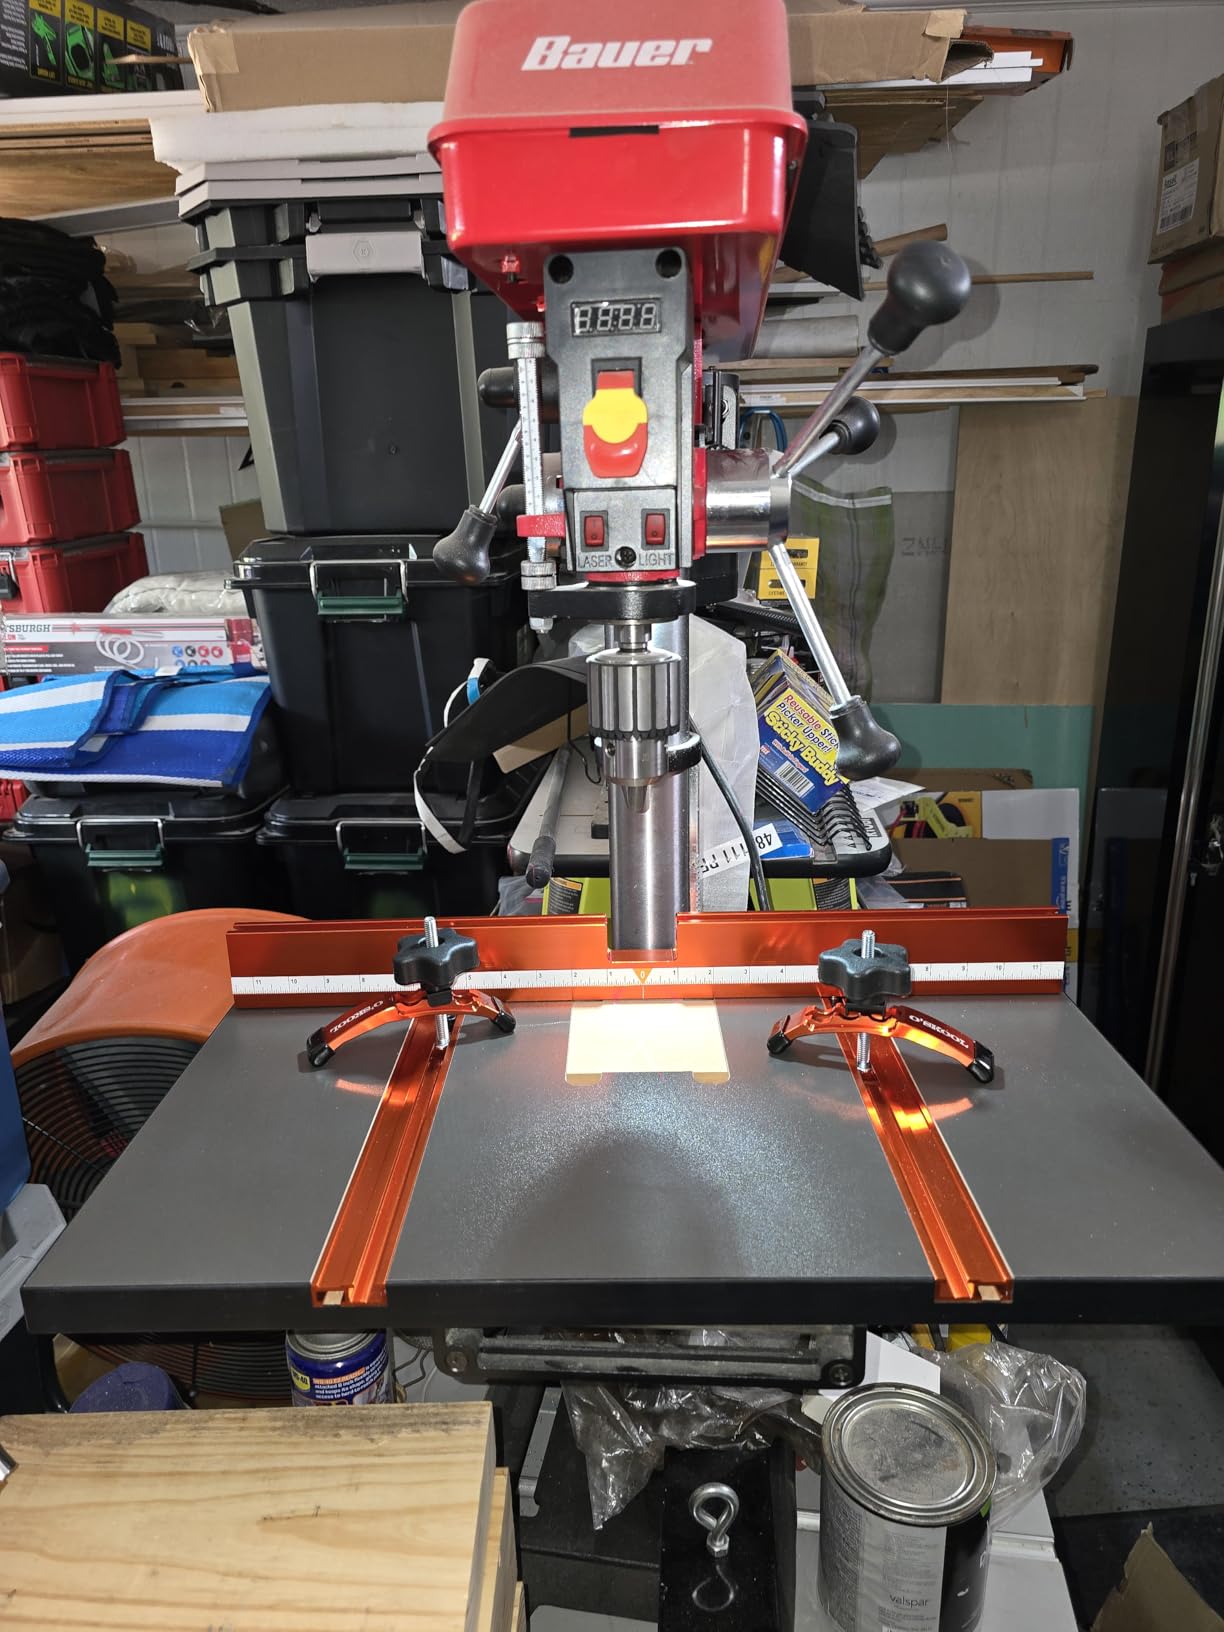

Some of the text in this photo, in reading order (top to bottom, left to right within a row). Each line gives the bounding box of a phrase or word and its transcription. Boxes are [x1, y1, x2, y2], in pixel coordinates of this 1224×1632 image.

[521, 35, 713, 71] Bauer
[577, 552, 674, 568] LASER LIGHT
[777, 702, 803, 729] Picker
[802, 726, 831, 754] Upper!
[784, 694, 822, 731] Reusable
[765, 711, 805, 752] Sticky
[800, 745, 841, 787] Buddy
[890, 1594, 929, 1608] valspar
